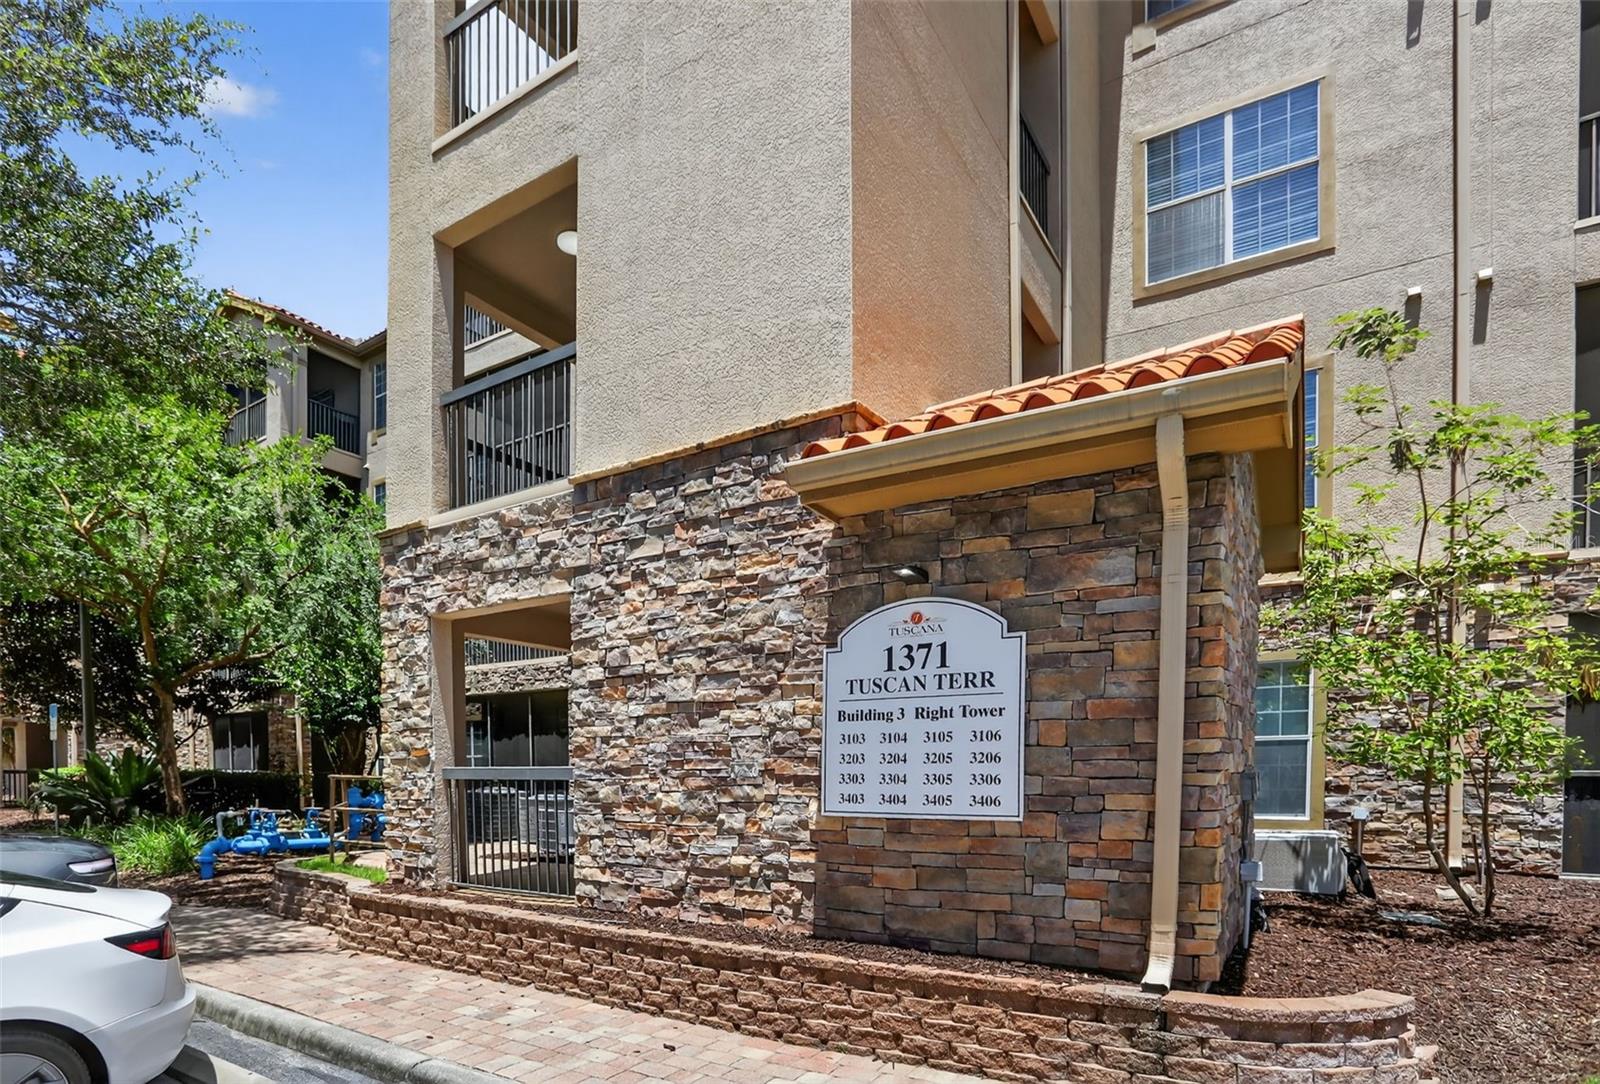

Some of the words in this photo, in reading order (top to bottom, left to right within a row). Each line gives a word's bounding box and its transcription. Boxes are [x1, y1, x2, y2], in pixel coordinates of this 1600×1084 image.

[888, 623, 944, 637] TUSCANA
[883, 641, 950, 673] 1371
[846, 674, 927, 695] TUSCAN
[934, 671, 996, 690] TERR
[837, 710, 893, 722] Building
[897, 708, 905, 720] 3
[915, 706, 954, 721] Right
[959, 705, 1006, 718] Tower
[839, 734, 866, 745] 3103
[880, 732, 908, 744] 3104
[923, 731, 953, 743] 3105
[970, 730, 1001, 742] 3106
[839, 754, 865, 764] 3203
[879, 752, 907, 764] 3204
[923, 752, 953, 764] 3205
[969, 752, 1001, 764] 3206
[839, 774, 865, 784] 3303
[879, 773, 907, 785] 3304
[923, 773, 953, 785] 3305
[969, 773, 1001, 785] 3306
[838, 793, 864, 804] 3403
[879, 794, 906, 805] 3404
[922, 794, 952, 806] 3405
[969, 795, 1001, 807] 3406
